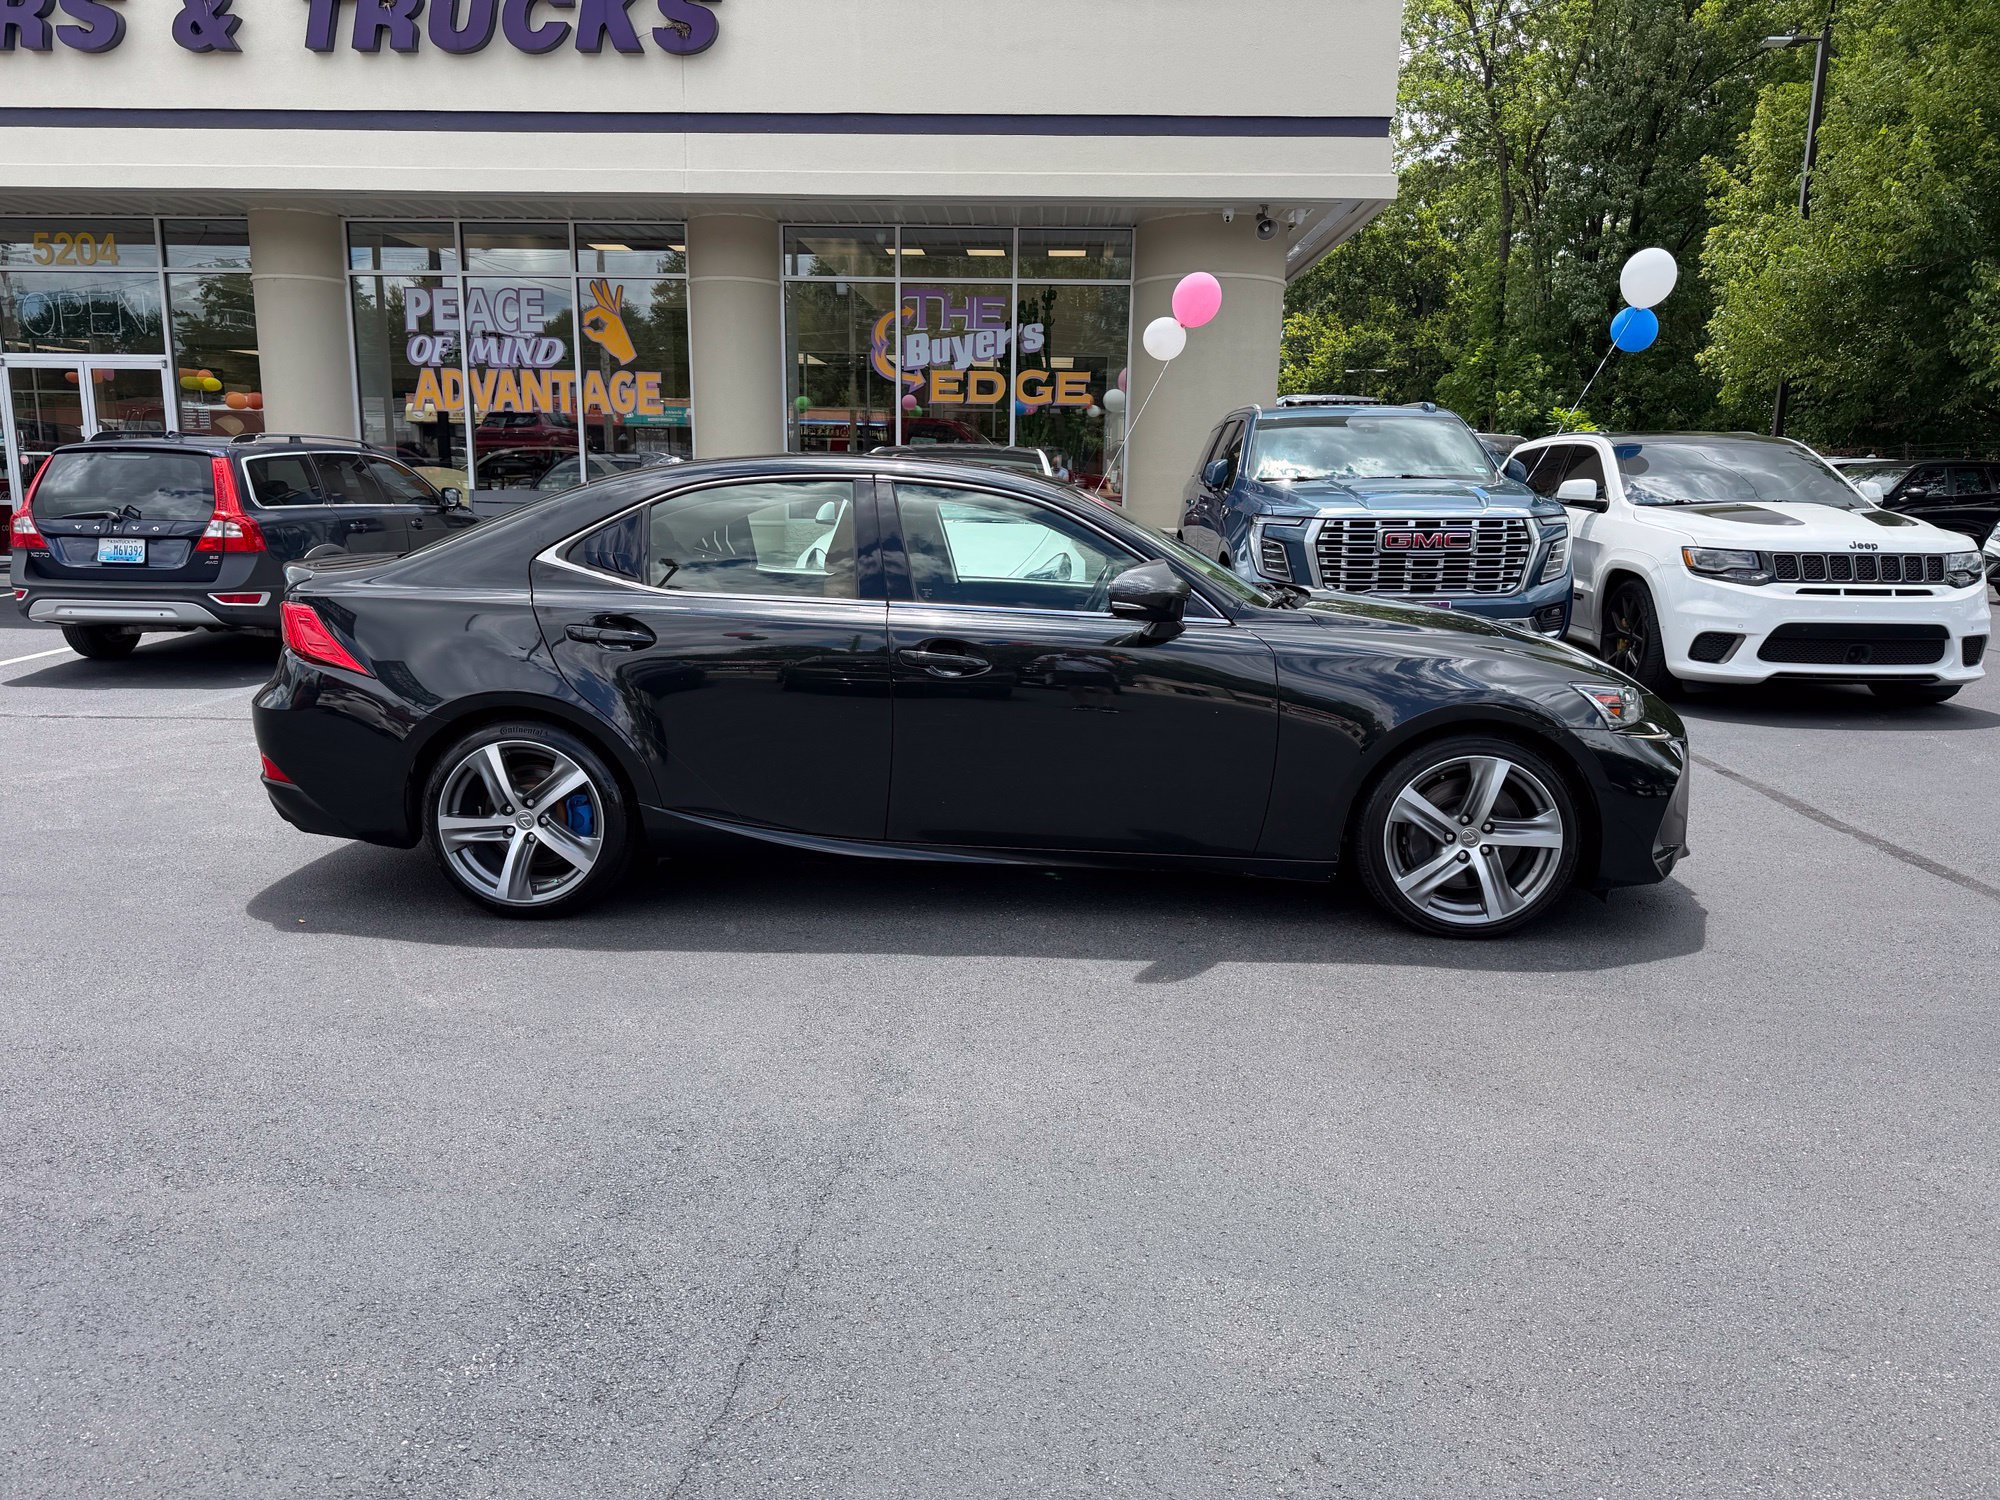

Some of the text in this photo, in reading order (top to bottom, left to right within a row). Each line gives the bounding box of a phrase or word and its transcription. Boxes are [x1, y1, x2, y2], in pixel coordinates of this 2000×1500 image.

[172, 0, 243, 53] &
[304, 0, 720, 54] TRUCKS
[33, 232, 119, 265] 5204
[22, 292, 148, 336] OPEN
[404, 287, 545, 333] PEACE
[902, 289, 1006, 331] THE
[407, 334, 565, 368] OF MIND
[903, 323, 1044, 371] Buyer's
[412, 368, 664, 415] ADVANTAGE
[928, 369, 1092, 406] EDGE
[74, 524, 160, 532] VOLVO
[1384, 533, 1471, 549] GMC
[113, 545, 144, 557] M6V392
[1849, 541, 1879, 551] Jeep
[500, 726, 543, 736] Continental
